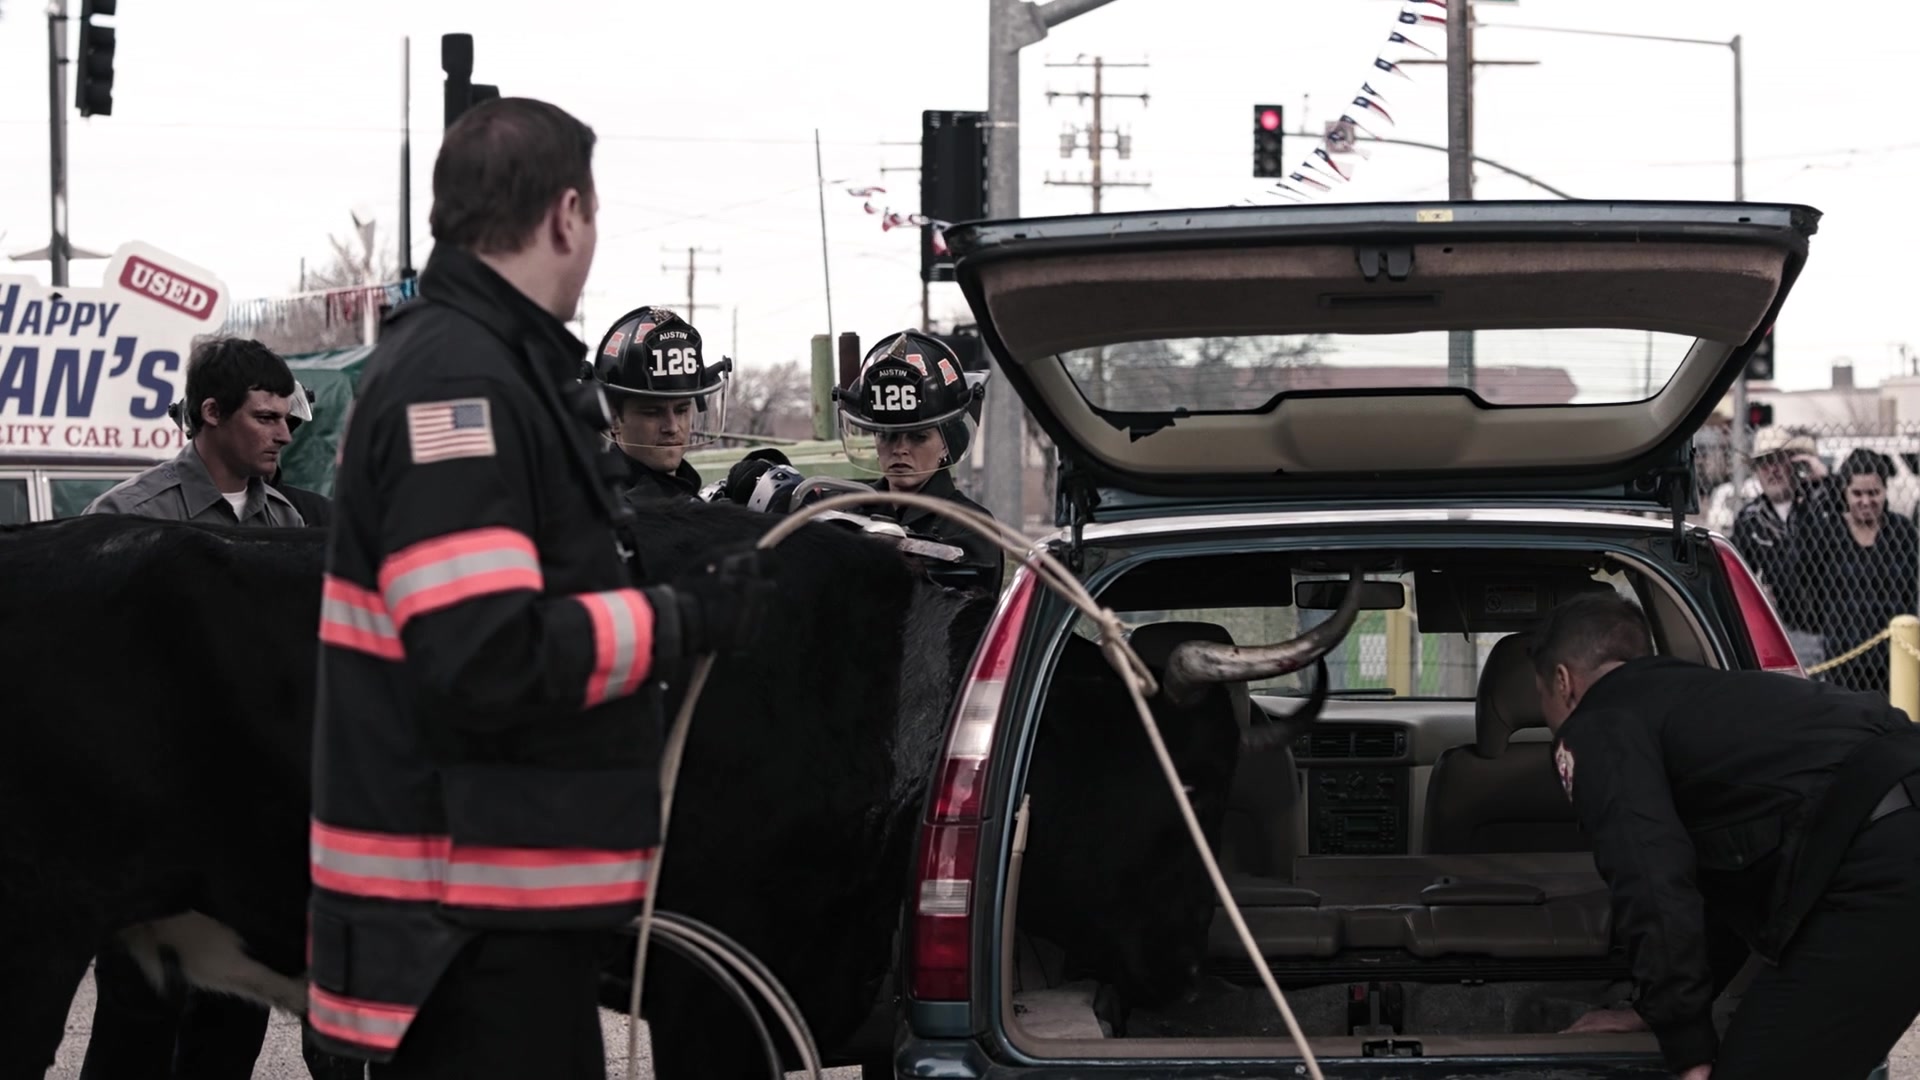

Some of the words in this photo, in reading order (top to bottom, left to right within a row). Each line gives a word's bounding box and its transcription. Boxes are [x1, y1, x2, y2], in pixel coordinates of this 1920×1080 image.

[131, 262, 209, 312] USED
[659, 331, 688, 341] AUSTIN
[652, 347, 697, 377] 126
[879, 369, 908, 377] AUSTIN
[0, 336, 180, 420] AN'S
[871, 384, 917, 411] 126
[0, 424, 54, 445] ITY
[64, 425, 122, 448] CAR
